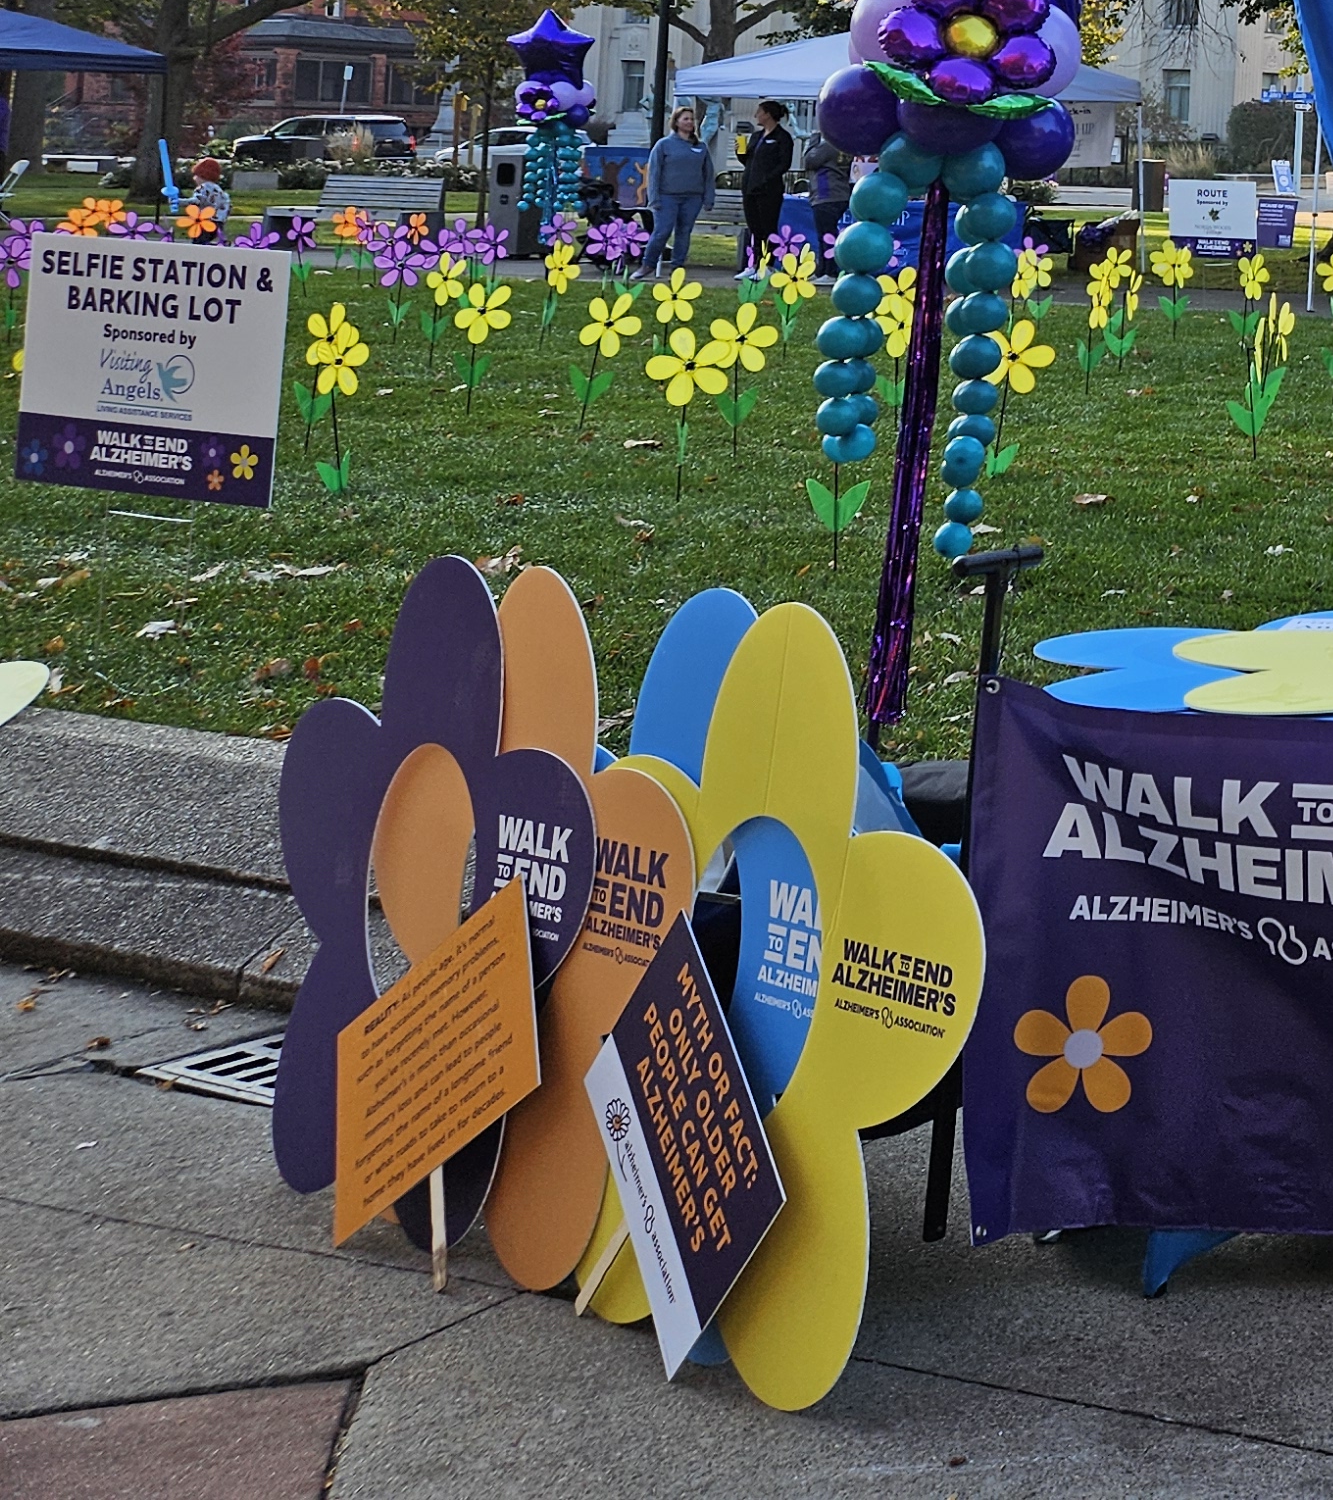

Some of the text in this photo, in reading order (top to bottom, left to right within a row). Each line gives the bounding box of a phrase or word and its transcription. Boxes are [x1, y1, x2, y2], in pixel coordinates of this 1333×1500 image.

[1197, 189, 1228, 198] ROUTE
[42, 250, 273, 292] SELFIE STATION &
[67, 286, 241, 324] BARKING LOT
[104, 324, 196, 349] Sponsored by
[100, 349, 153, 383] Visiting
[97, 405, 192, 421] LIVING ASSISTANCE SERVICES
[90, 446, 192, 470] ALZHEIMER'S
[97, 430, 188, 453] WALK END
[144, 475, 184, 484] ASSOCIATION
[1062, 753, 1280, 838] WALK
[499, 814, 573, 863] WALK
[497, 858, 566, 901] TO END
[596, 836, 669, 889] WALK
[594, 883, 664, 928] TO END
[1069, 895, 1253, 940] ALZHEIMER'S
[582, 942, 614, 958] ALZHEIMER'S
[585, 917, 661, 950] ALZHEIMER'S
[768, 935, 783, 951] TO
[364, 915, 495, 1037] REALITY: As people age, it's normal
[844, 938, 953, 987] WALK TO END
[372, 932, 499, 1051] have occasional memory problems,
[754, 992, 791, 1012] ALZHEIMER'S
[831, 963, 956, 1016] ALZHEIMER'S
[834, 998, 879, 1020] ALZHEIMER'S
[894, 1015, 943, 1038] ASSOCIATION
[676, 961, 759, 1190] MYTH OR FACT:
[669, 1008, 738, 1199] ONLY OLDER
[643, 1002, 732, 1253] PEOPLE CAN GET
[636, 1055, 705, 1253] ALZHEIMER'S
[624, 1139, 675, 1305] alzheimer's association
